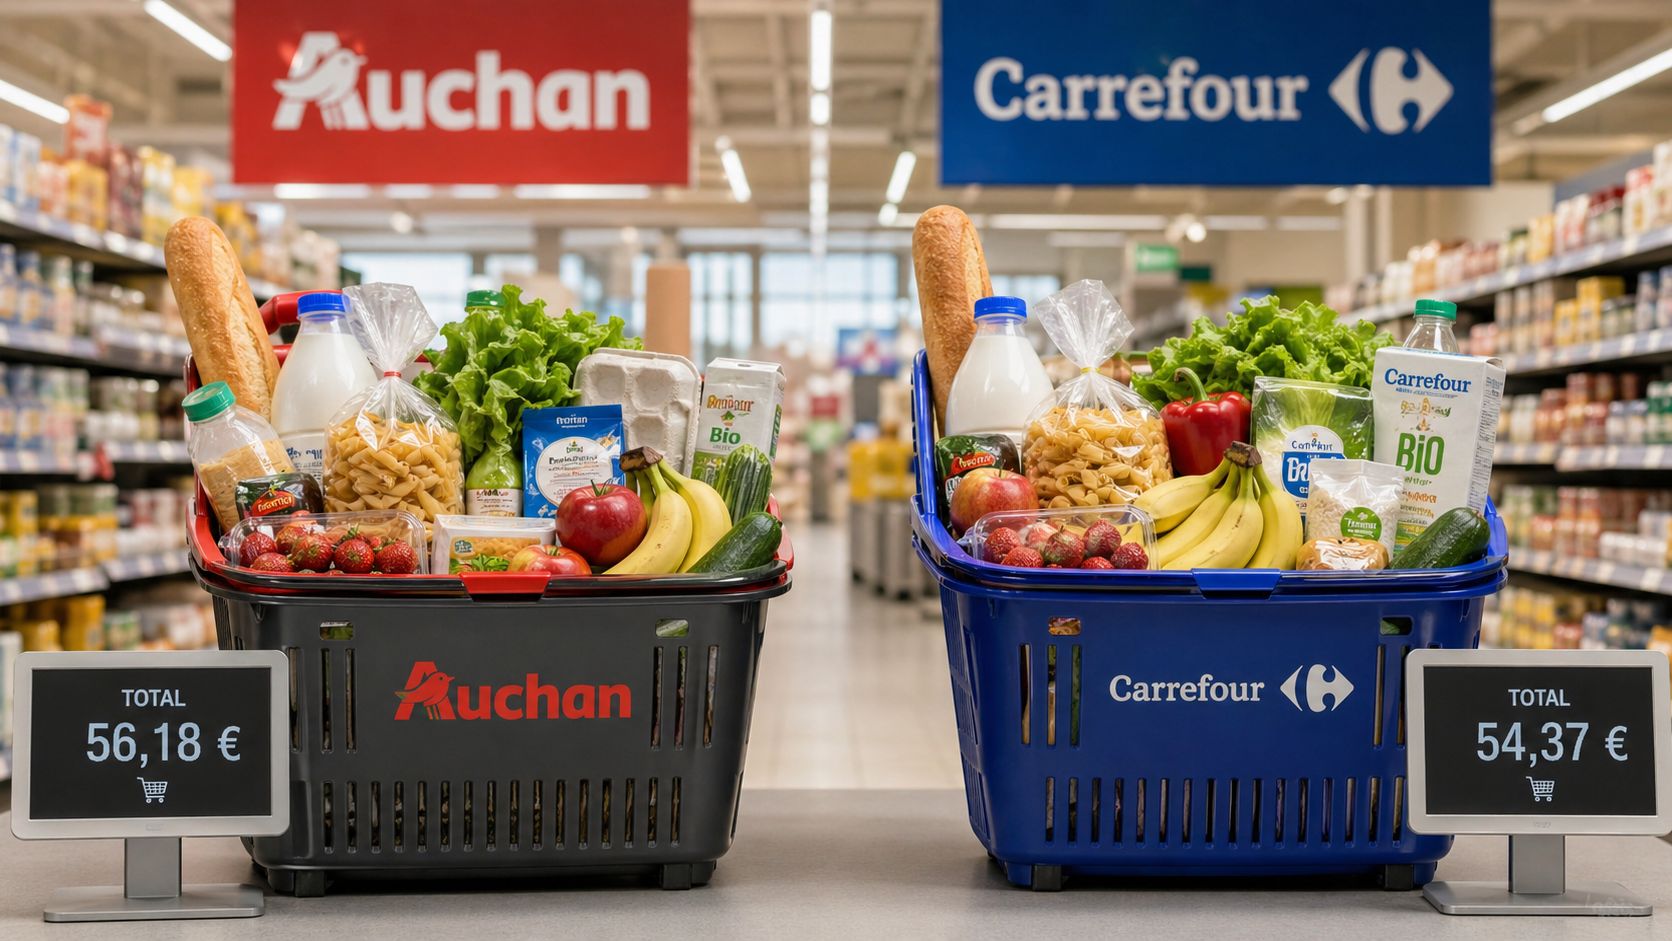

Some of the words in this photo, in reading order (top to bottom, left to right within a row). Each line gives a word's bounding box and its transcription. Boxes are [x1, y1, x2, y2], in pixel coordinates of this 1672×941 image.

[273, 32, 650, 131] Auchan
[975, 58, 1307, 120] Carrefour
[1384, 367, 1472, 393] Carrefour
[709, 427, 741, 445] Bio
[121, 688, 187, 707] TOTAL
[394, 661, 632, 721] Auchan
[1109, 673, 1265, 702] Carrefour
[1507, 688, 1571, 707] TOTAL
[86, 722, 201, 769] 56,18
[217, 725, 241, 763] €
[1476, 721, 1589, 768] 54,37
[1604, 725, 1628, 762] €
